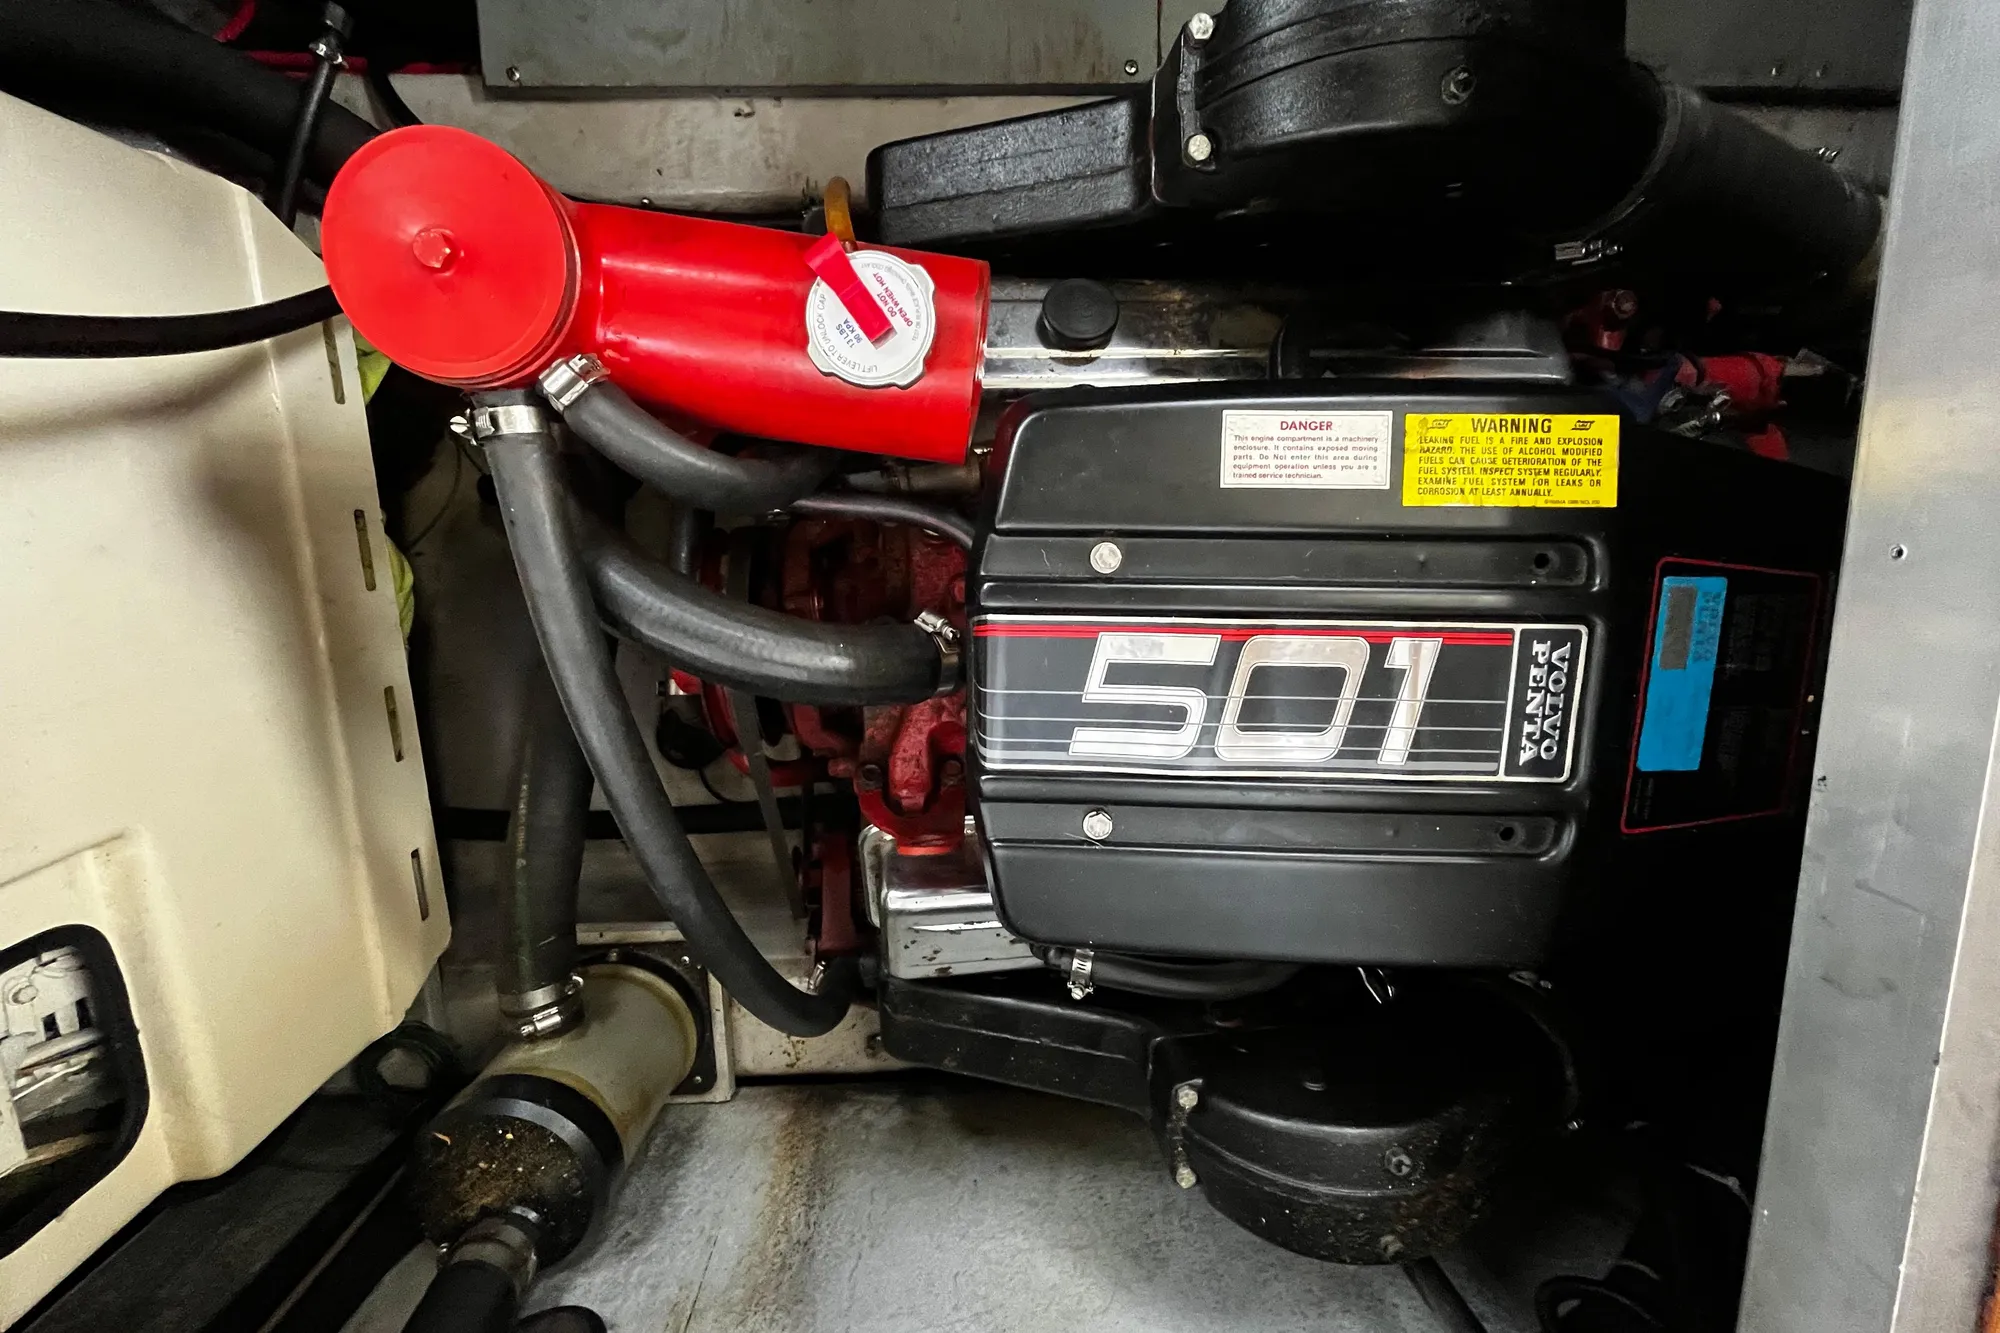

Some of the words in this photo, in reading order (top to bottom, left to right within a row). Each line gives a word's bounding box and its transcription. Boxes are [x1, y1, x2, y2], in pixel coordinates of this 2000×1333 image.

[872, 272, 886, 288] HOT
[817, 294, 827, 311] CAP
[877, 292, 890, 307] NOT
[883, 286, 900, 308] WHEN
[887, 306, 897, 318] DO
[897, 307, 914, 327] OPEN
[816, 312, 832, 345] UNLOCK
[835, 323, 850, 340] LBS
[843, 318, 857, 335] KPA
[846, 339, 855, 349] 13
[853, 333, 863, 344] 90
[828, 344, 838, 357] TO
[837, 353, 861, 370] LEVER
[862, 364, 878, 373] LIFT
[1280, 421, 1333, 430] DANGER
[1472, 418, 1552, 433] WARNING
[1419, 436, 1454, 444] LEAKING
[1503, 447, 1513, 455] OF
[1518, 447, 1556, 455] ALCOHOL
[1562, 448, 1602, 456] MODIFIED
[1449, 457, 1465, 465] CAN
[1471, 457, 1497, 465] CAUSE
[1502, 457, 1566, 466] DETERIORATION
[1571, 458, 1581, 466] OF
[1518, 468, 1549, 476] SYSTEM
[1554, 468, 1602, 477] REGULARLY.
[1418, 477, 1457, 485] EXAMINE
[1491, 478, 1525, 486] SYSTEM
[1533, 478, 1549, 486] FOR
[1556, 479, 1582, 487] LEAKS
[1589, 479, 1601, 487] OR
[1510, 489, 1553, 497] ANNUALLY.
[1069, 632, 1443, 765] 501
[1519, 639, 1551, 766] PENTA
[1540, 641, 1571, 760] VOLVO
